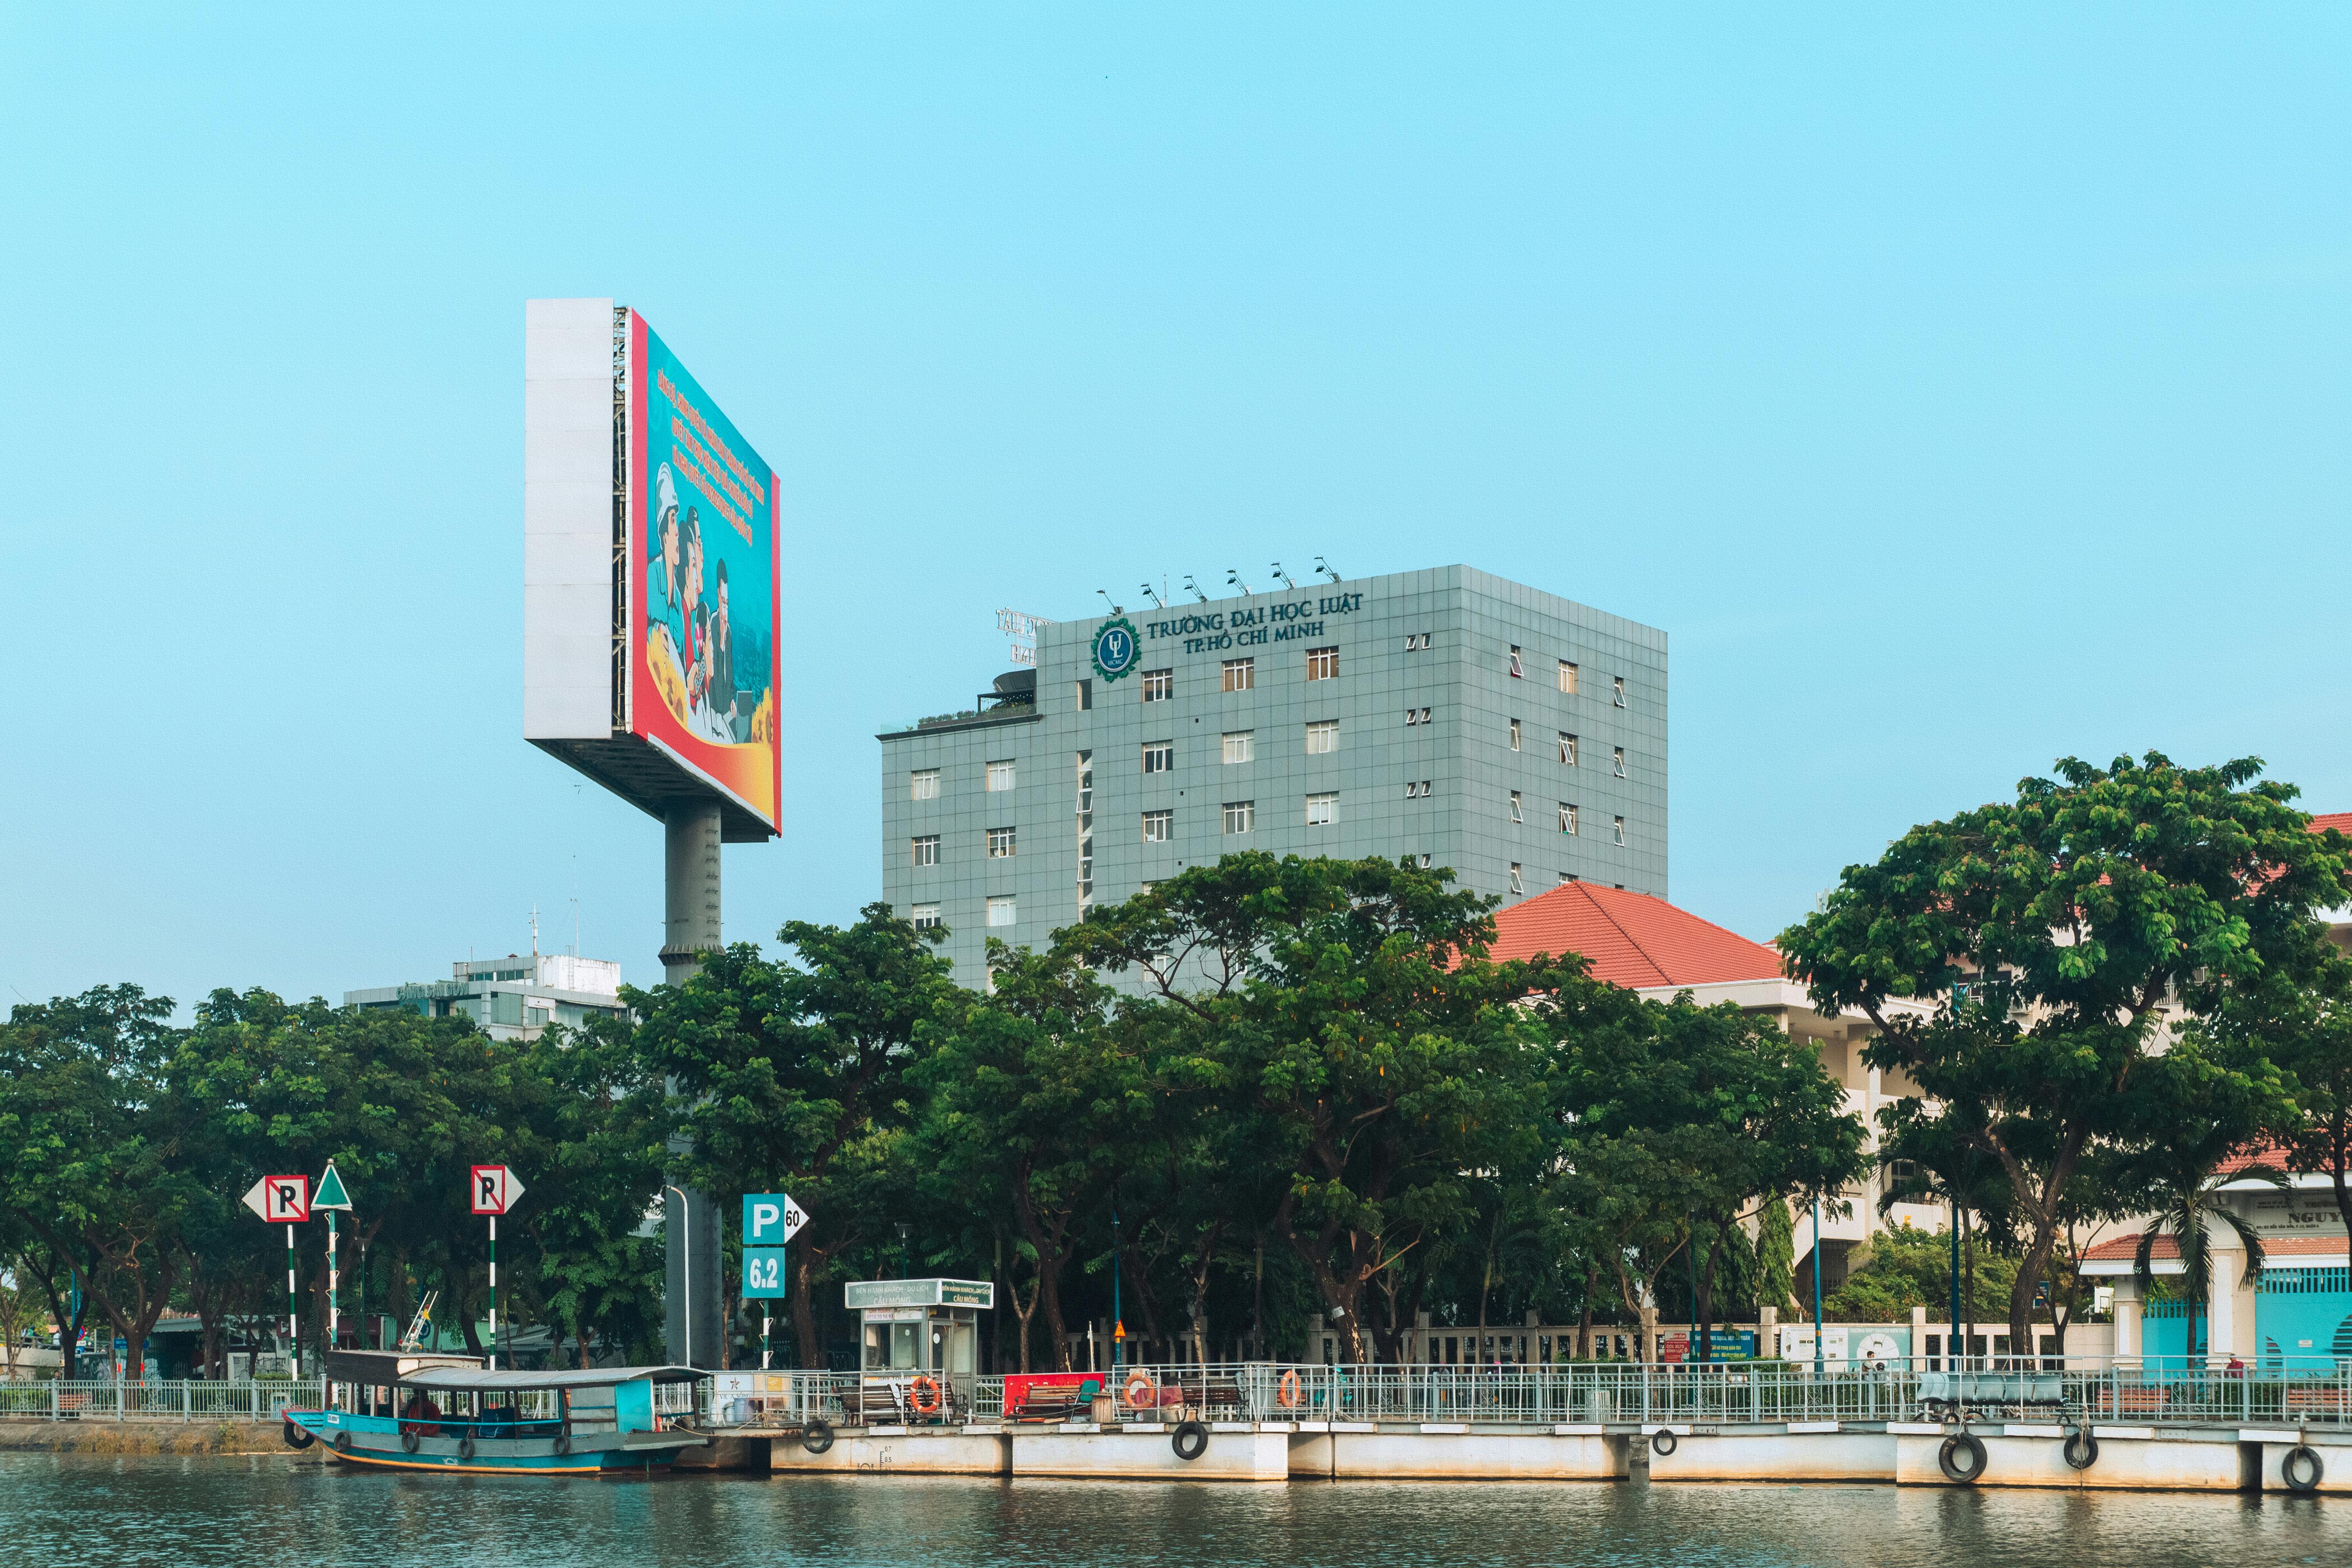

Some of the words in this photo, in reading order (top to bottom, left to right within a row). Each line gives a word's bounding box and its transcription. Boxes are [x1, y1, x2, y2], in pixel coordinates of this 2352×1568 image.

[1147, 613, 1224, 639] TRƯỜNG
[1230, 607, 1264, 628] ĐẠI
[1271, 600, 1312, 622] HỌC
[1319, 592, 1363, 615] LUẬT
[1183, 629, 1232, 654] TP.HỒ
[1237, 625, 1268, 646] CHÍ
[1274, 621, 1324, 642] MINH
[280, 1186, 296, 1213] P
[482, 1177, 495, 1205] P
[753, 1204, 780, 1237] P
[785, 1210, 800, 1227] 60
[750, 1258, 778, 1289] 6.2
[856, 1285, 867, 1294] BẾN
[884, 1285, 904, 1294] KHÁCH
